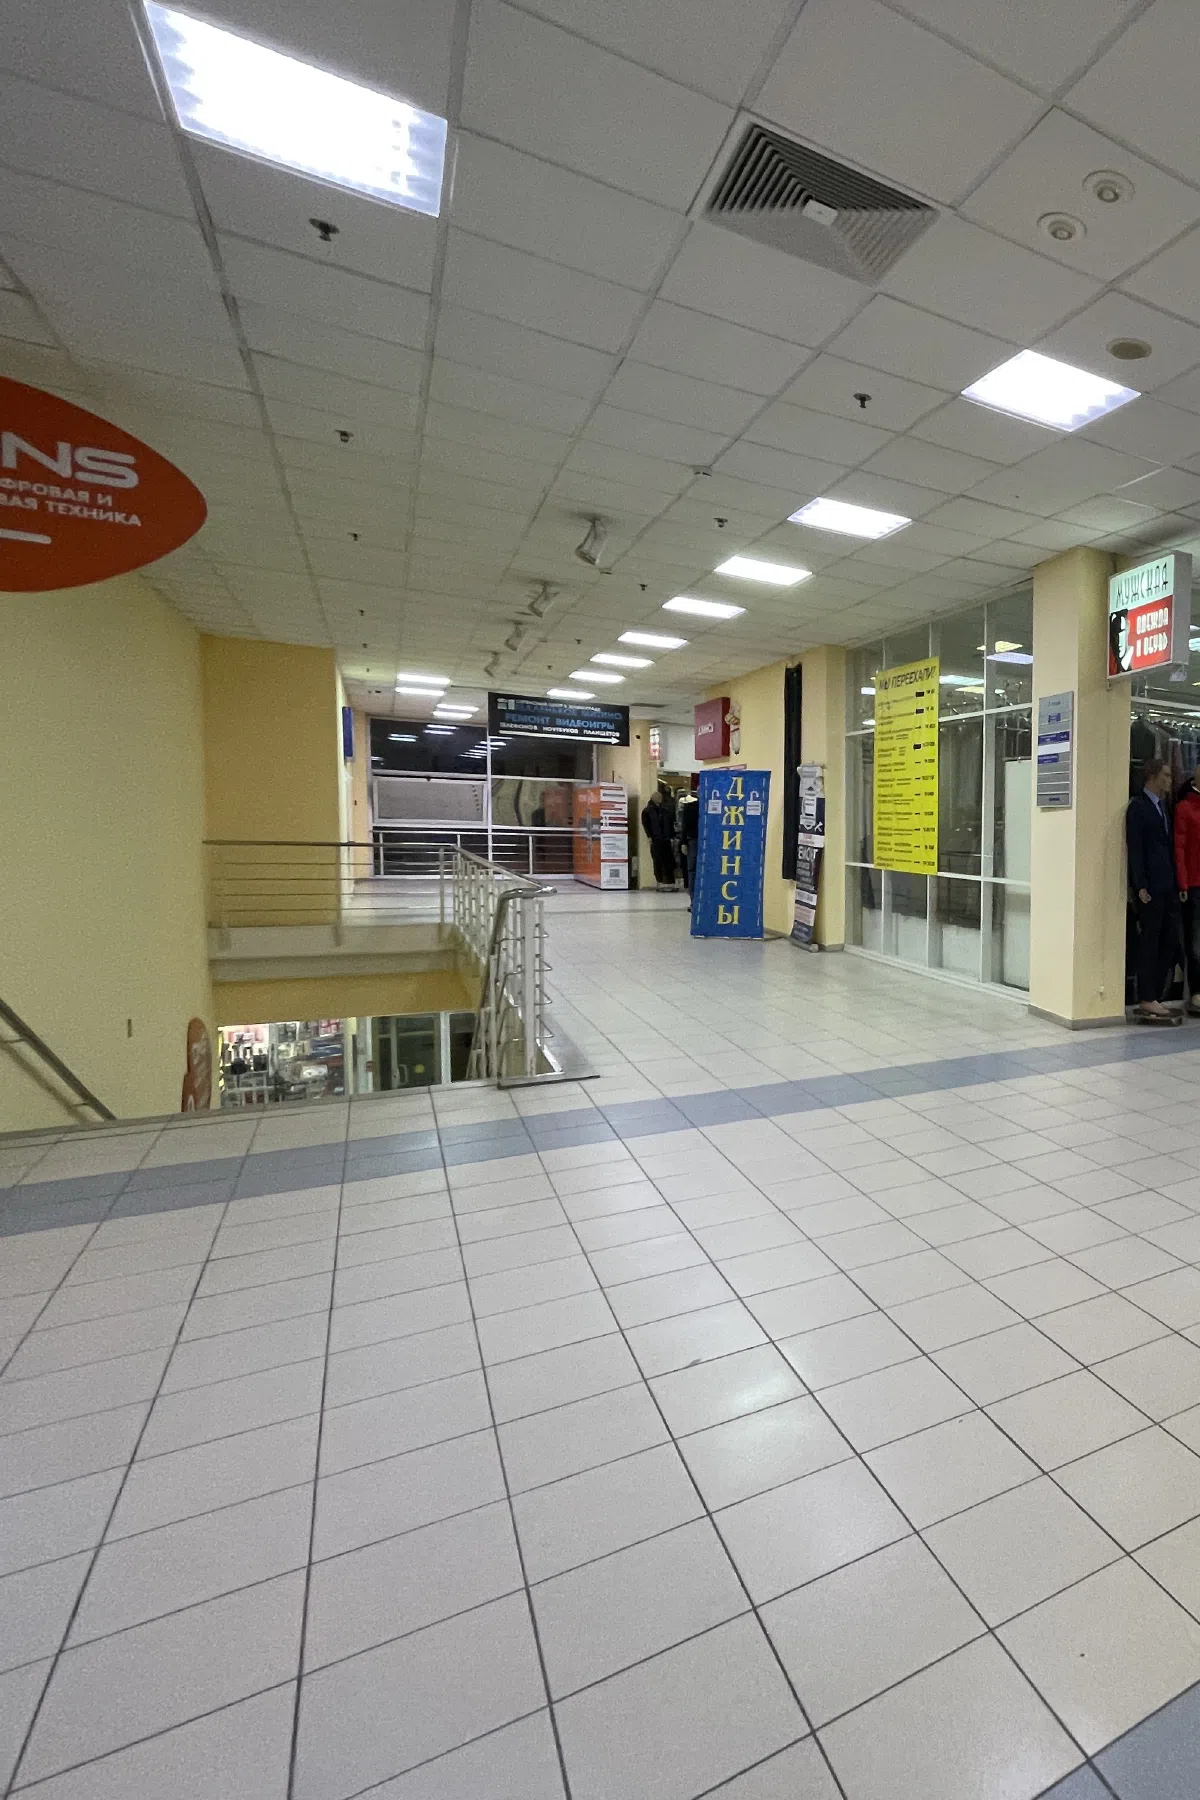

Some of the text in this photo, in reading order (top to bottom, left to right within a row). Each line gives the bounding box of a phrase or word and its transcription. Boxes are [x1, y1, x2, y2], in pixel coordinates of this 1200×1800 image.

[46, 500, 142, 527] ТЕХНИКА
[97, 493, 113, 507] И
[1115, 562, 1169, 608] МУЖСКАЯ
[1136, 607, 1169, 636] ОДЕЖДА
[1143, 631, 1169, 656] ОБУВЬ
[717, 776, 746, 926] ДЖИНСЫ
